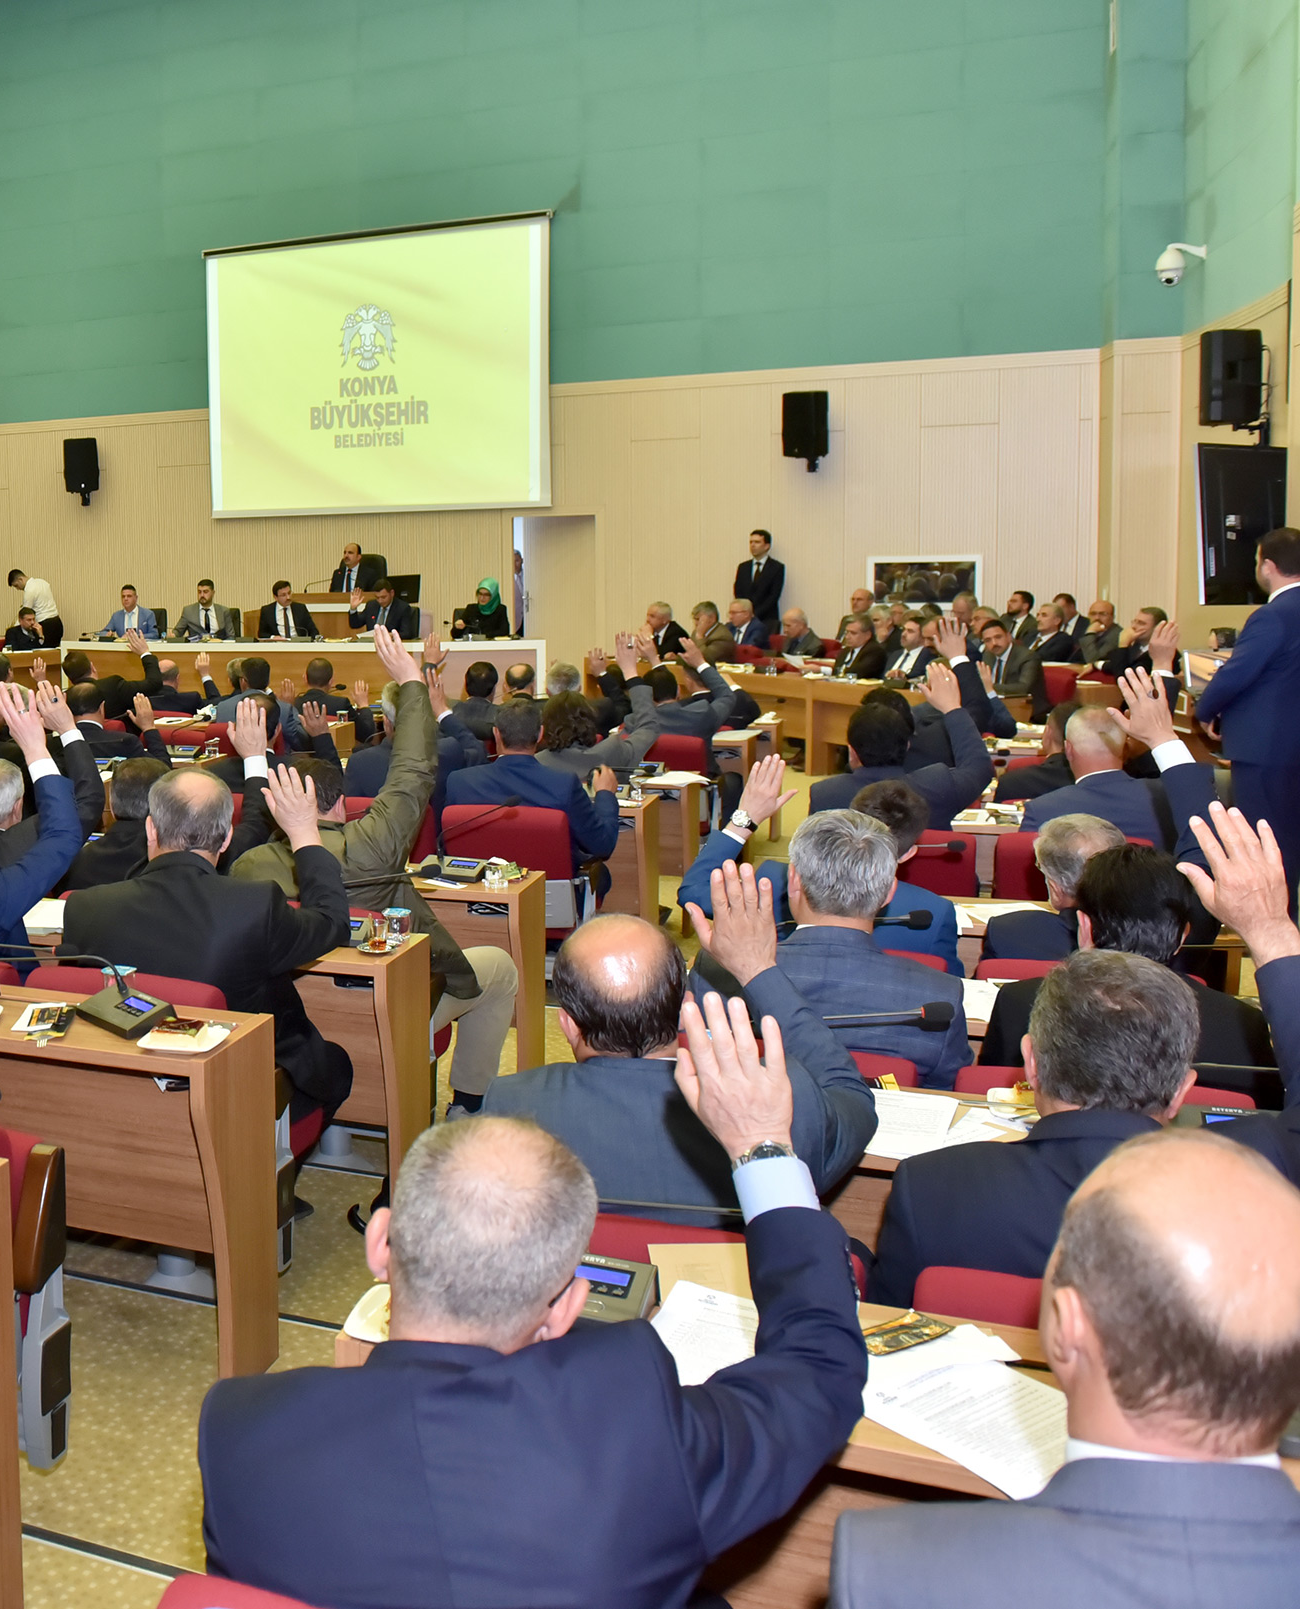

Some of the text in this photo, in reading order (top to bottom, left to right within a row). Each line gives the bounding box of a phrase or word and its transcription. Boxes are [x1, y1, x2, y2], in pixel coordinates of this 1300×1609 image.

[339, 375, 398, 398] KONYA
[310, 395, 429, 431] BÜYÜKŞEHİR
[334, 428, 404, 449] BELEDİYESİ
